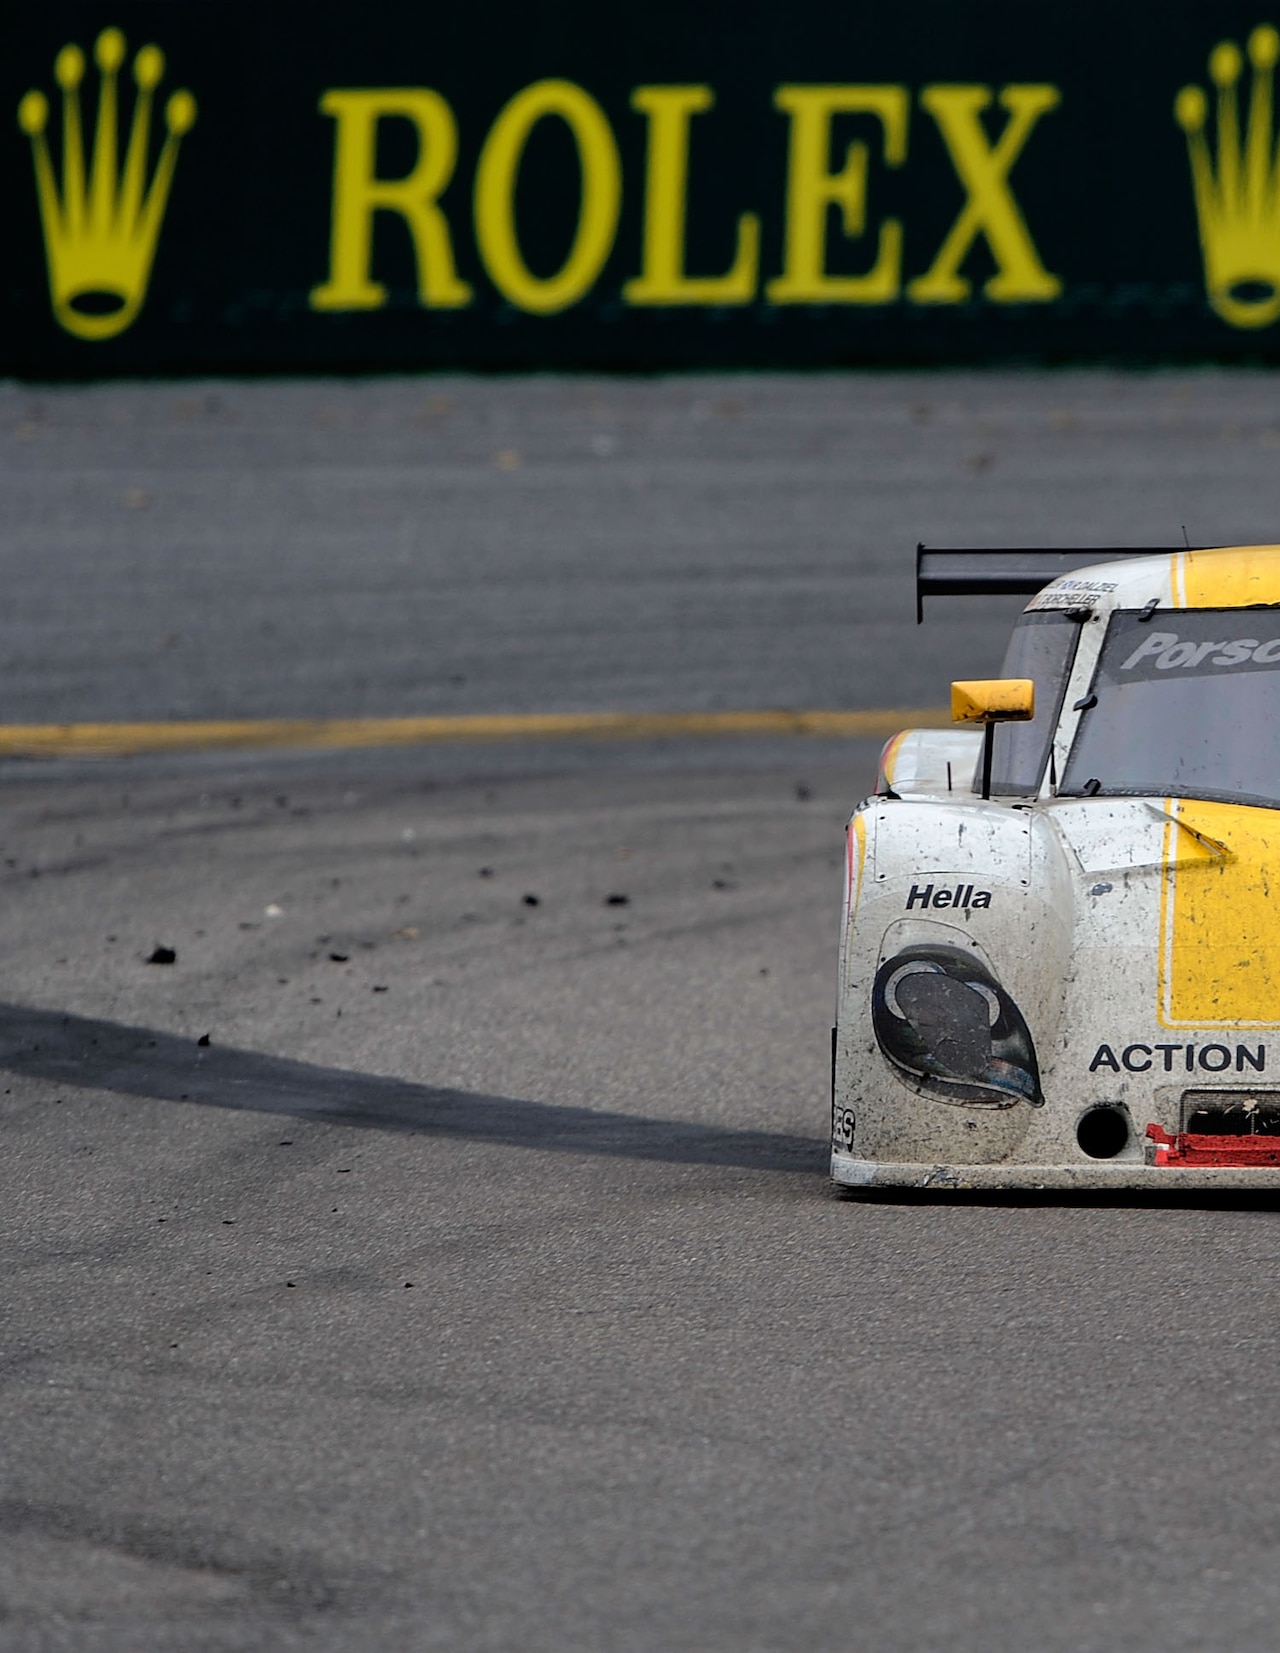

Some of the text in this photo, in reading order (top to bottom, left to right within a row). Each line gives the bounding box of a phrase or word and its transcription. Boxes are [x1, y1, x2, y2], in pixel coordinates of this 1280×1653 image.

[309, 78, 1062, 313] ROLEX
[906, 884, 992, 910] Hella
[1088, 1043, 1266, 1073] ACTION
